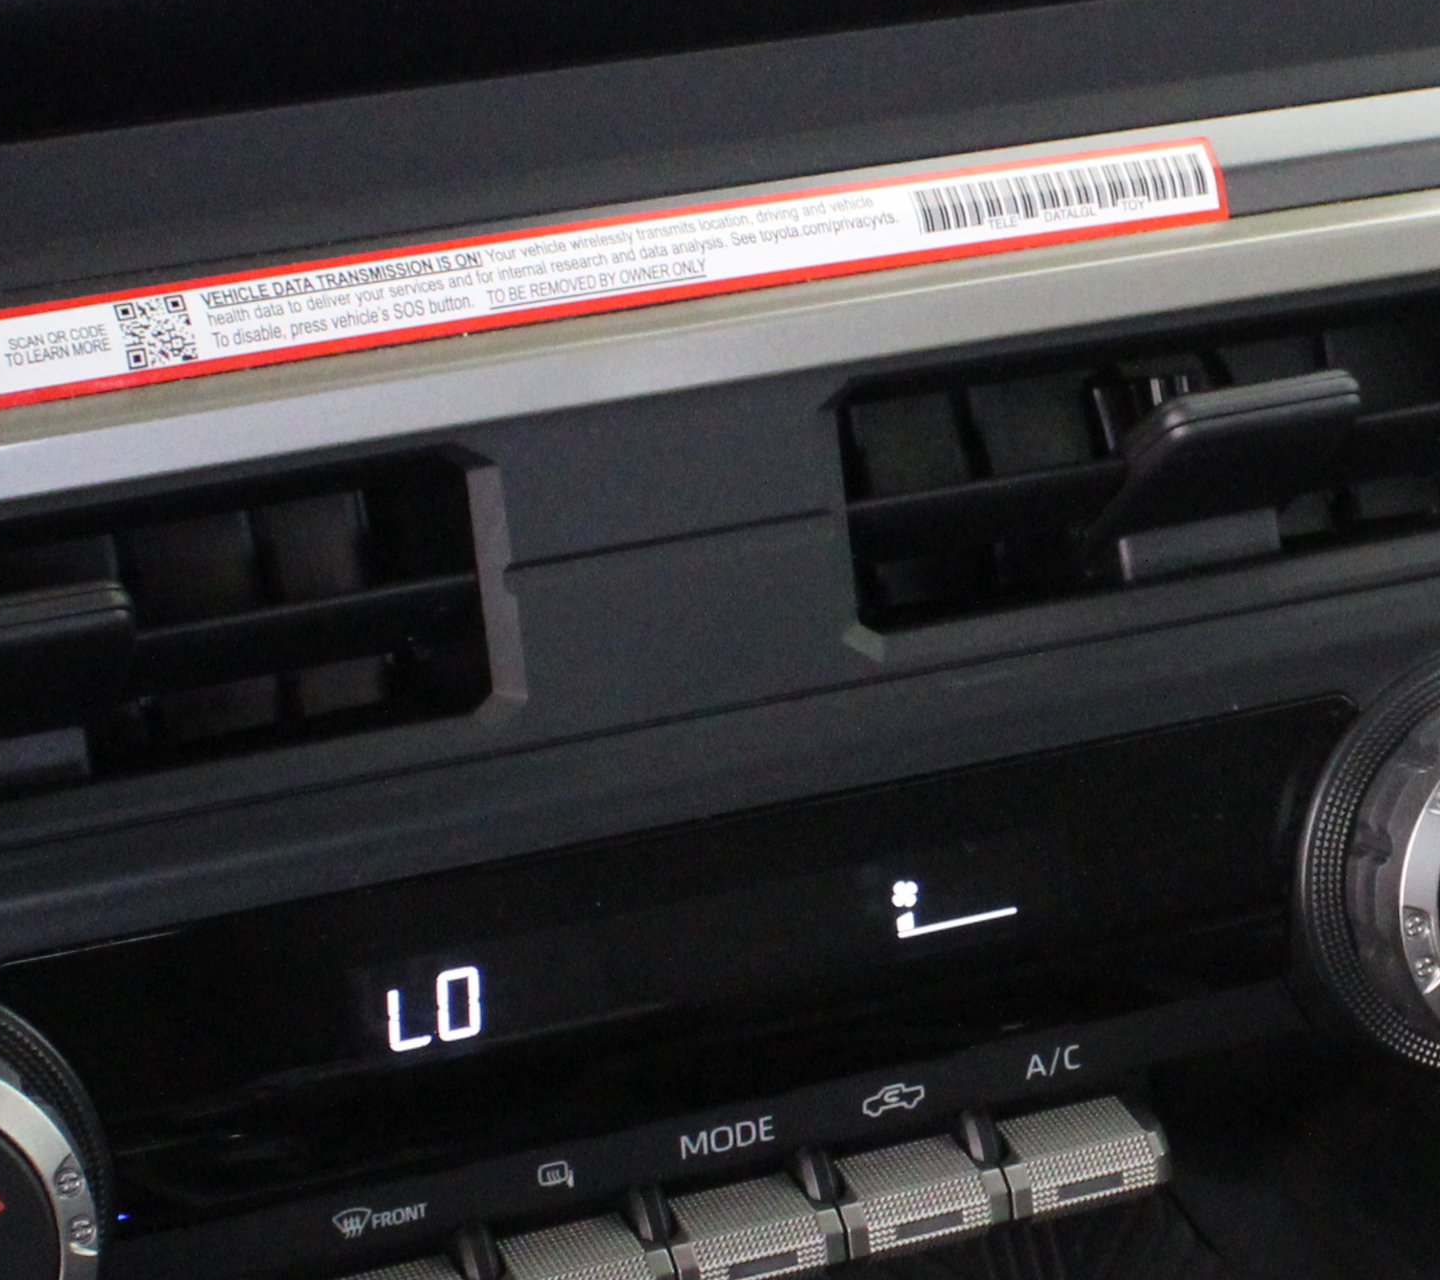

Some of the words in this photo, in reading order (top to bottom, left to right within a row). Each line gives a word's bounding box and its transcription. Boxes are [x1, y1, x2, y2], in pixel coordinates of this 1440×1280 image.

[988, 216, 1018, 231] TELE
[1043, 207, 1097, 223] DATALGL
[1121, 198, 1145, 212] TOY
[200, 282, 270, 308] VEHICLE
[272, 274, 315, 299] DATA
[316, 259, 434, 289] TRANSMISSION
[437, 254, 452, 271] IS
[455, 251, 484, 268] ON!
[485, 247, 517, 264] Your
[519, 238, 566, 258] vehicle
[570, 230, 634, 251] wirelessly
[636, 222, 696, 241] transmits
[698, 212, 755, 232] location,
[755, 205, 800, 224] driving
[802, 199, 827, 216] and
[829, 195, 874, 213] vehicle
[207, 306, 251, 327] health
[254, 301, 286, 320] data
[288, 299, 303, 314] to
[306, 292, 352, 312] deliver
[354, 289, 386, 308] your
[388, 279, 446, 299] services
[448, 272, 474, 290] and
[475, 268, 495, 285] for
[497, 260, 548, 281] internal
[550, 251, 609, 274] research
[611, 247, 637, 265] and
[639, 241, 670, 260] data
[672, 234, 728, 256] analysis.
[731, 230, 758, 247] See
[759, 213, 900, 245] toyota.com/privacyvts.
[212, 332, 230, 349] To
[233, 323, 287, 347] disable,
[290, 320, 328, 340] press
[330, 306, 391, 329] vehicle's
[393, 303, 426, 320] SOS
[429, 295, 476, 316] button.
[486, 287, 507, 305] TO
[508, 283, 528, 301] BE
[529, 274, 597, 298] REMOVED
[598, 271, 616, 289] BY
[618, 263, 669, 286] OWNER
[672, 258, 706, 276] ONLY
[4, 351, 24, 368] TO
[26, 345, 71, 365] LEARN
[72, 337, 112, 357] MORE
[7, 333, 45, 351] SCAN
[47, 330, 68, 345] QR
[70, 324, 108, 341] CODE
[1025, 1044, 1082, 1080] A/C
[679, 1115, 776, 1161] MODE
[371, 1201, 429, 1230] FRONT
